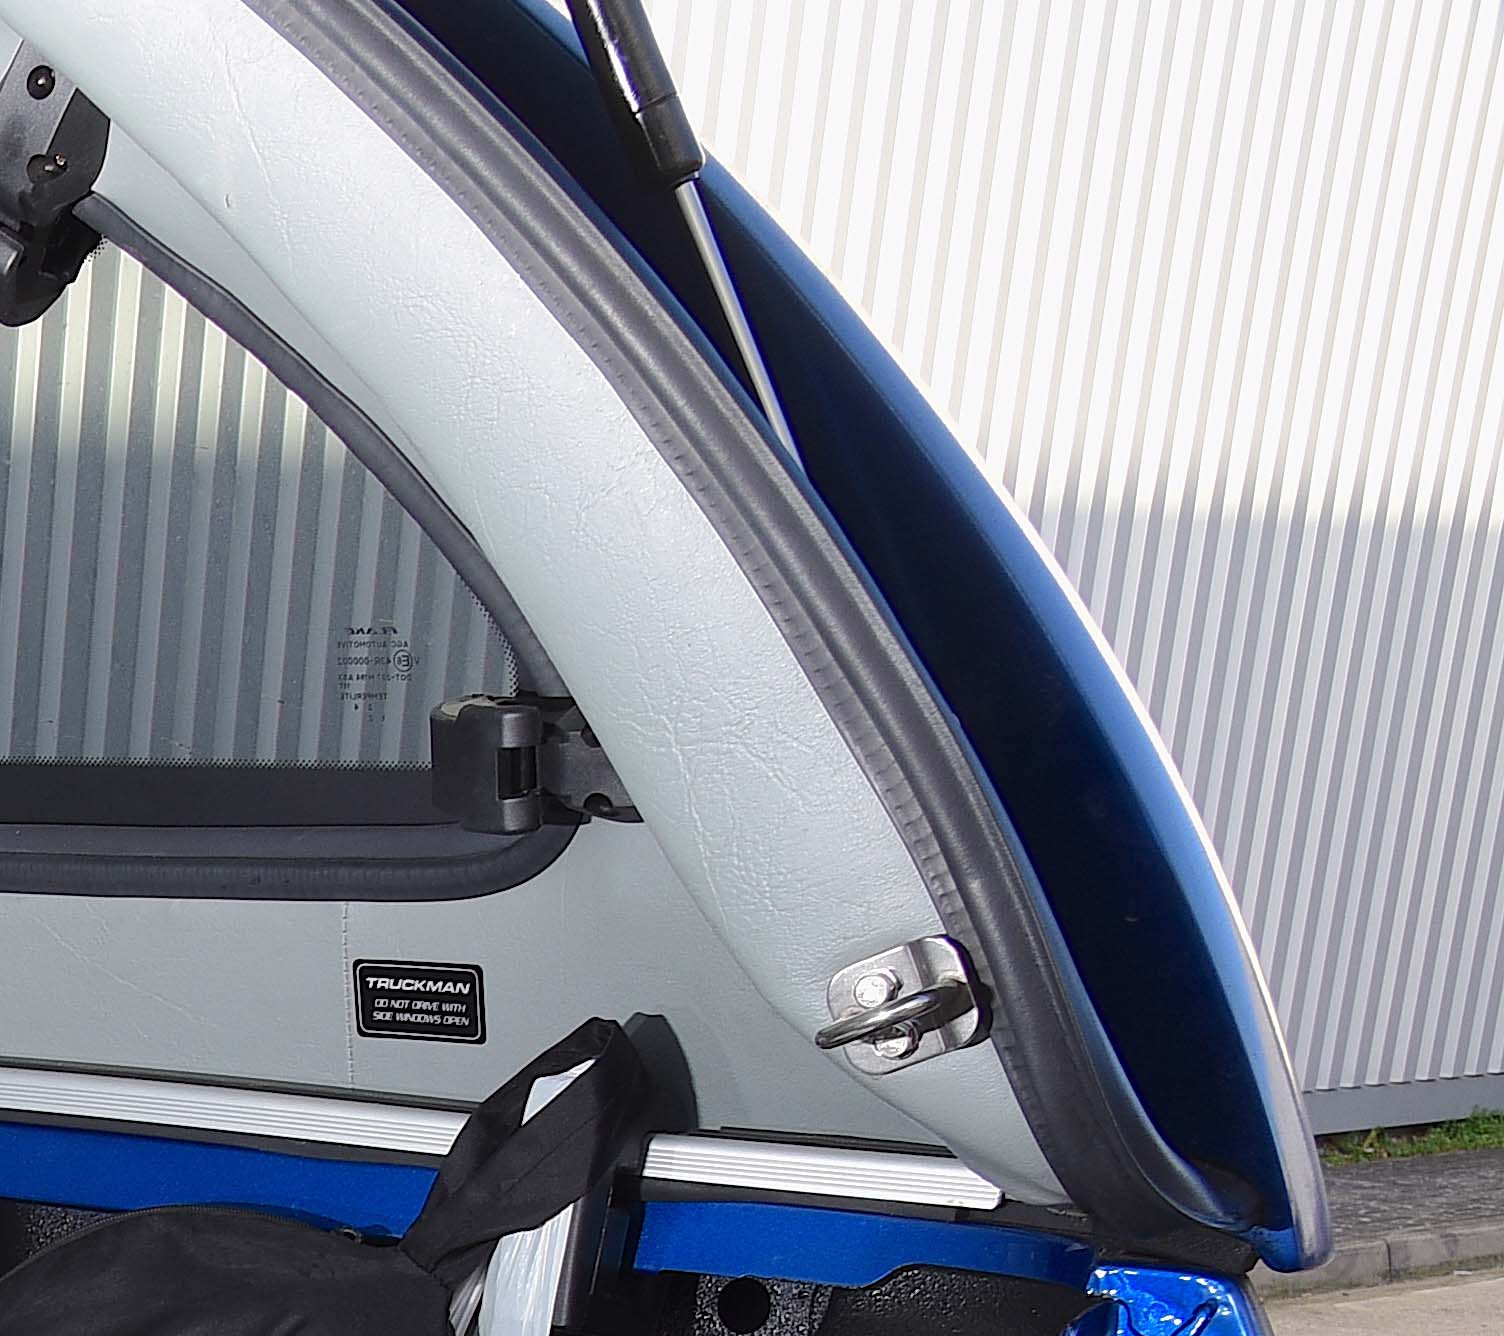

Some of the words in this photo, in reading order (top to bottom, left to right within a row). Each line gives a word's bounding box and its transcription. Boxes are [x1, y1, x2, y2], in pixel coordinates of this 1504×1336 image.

[365, 976, 471, 995] TRUCKMAN
[374, 998, 389, 1008] DO
[390, 999, 410, 1010] NOT
[412, 1000, 440, 1012] DRIVE
[442, 1002, 467, 1013] WITH
[372, 1010, 393, 1022] SIDE
[395, 1012, 442, 1025] WINDOWS
[443, 1015, 470, 1026] OPEN
